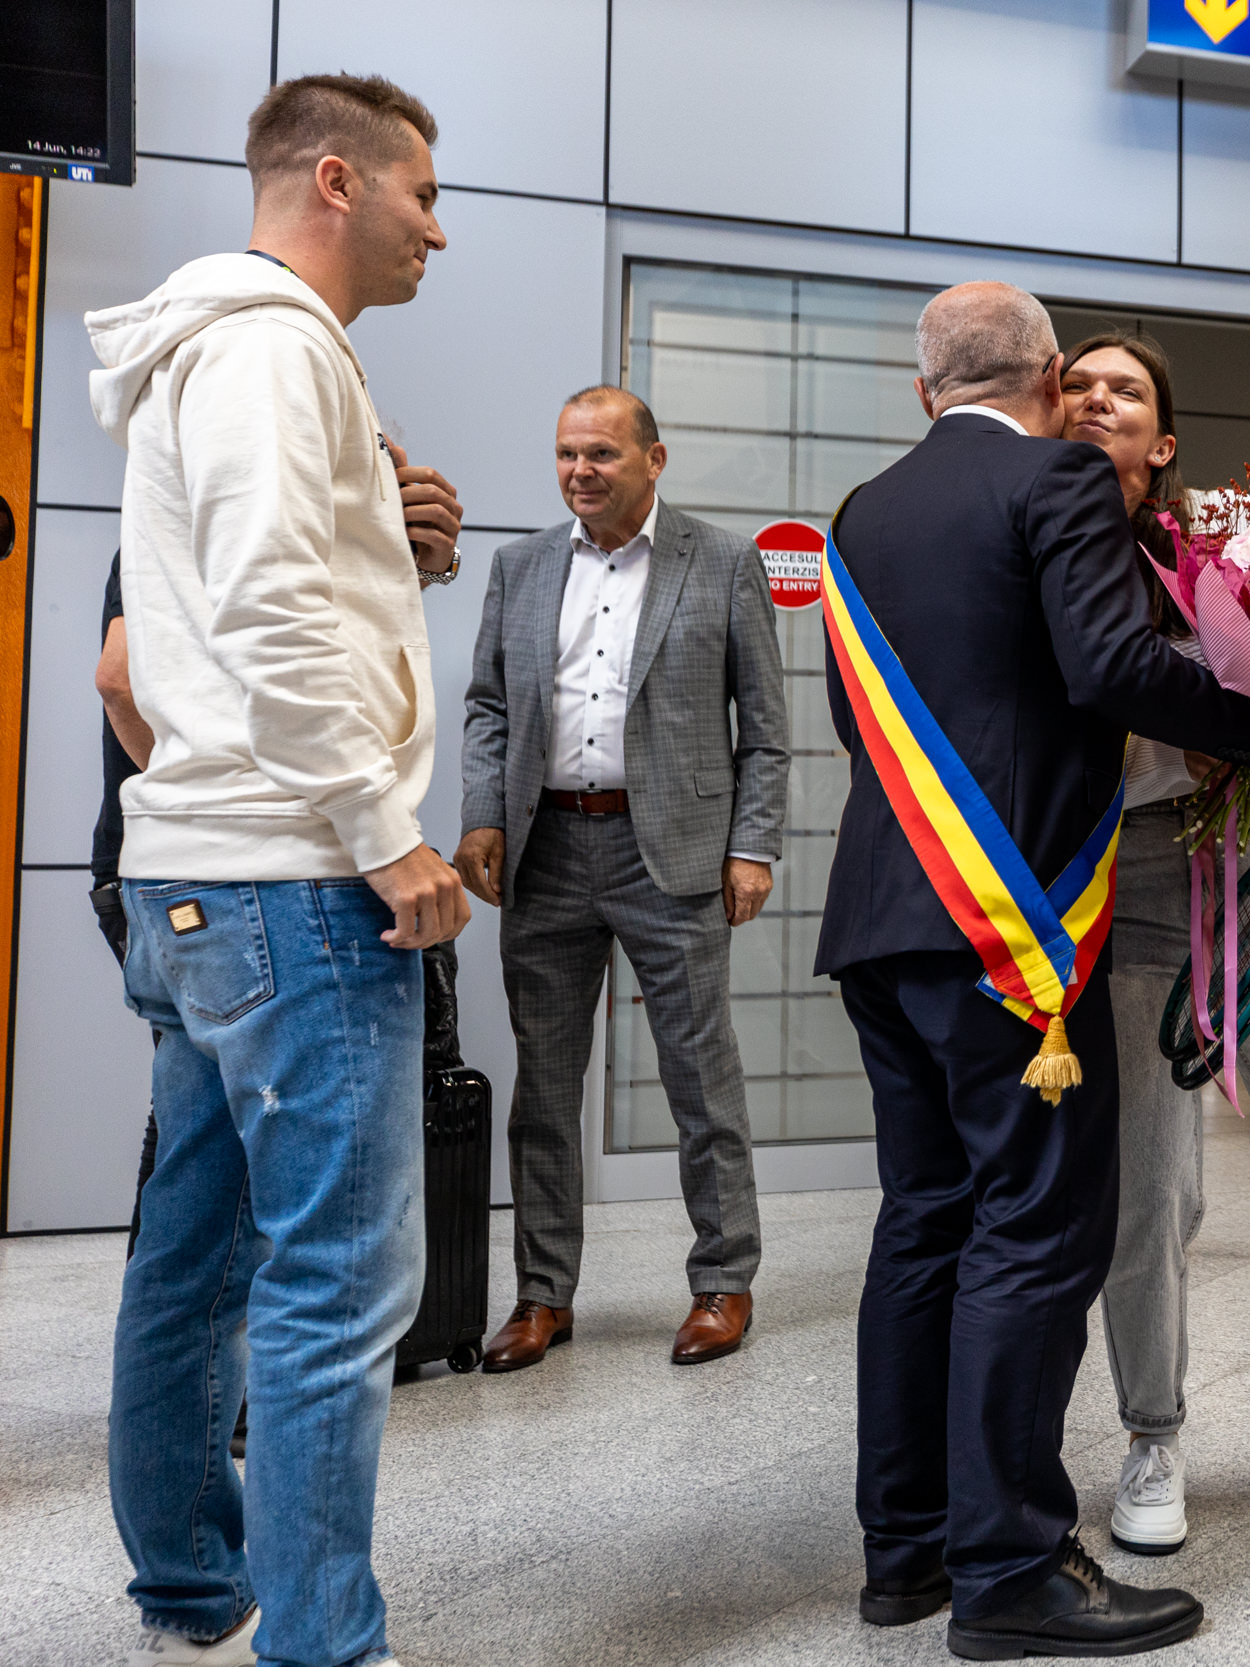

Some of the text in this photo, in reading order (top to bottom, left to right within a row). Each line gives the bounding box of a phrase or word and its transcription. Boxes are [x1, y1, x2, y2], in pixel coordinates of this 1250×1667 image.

[27, 140, 40, 151] 14
[763, 552, 821, 564] ACCESUL
[768, 566, 819, 577] NTERZIS
[770, 580, 818, 592] O ENTRY
